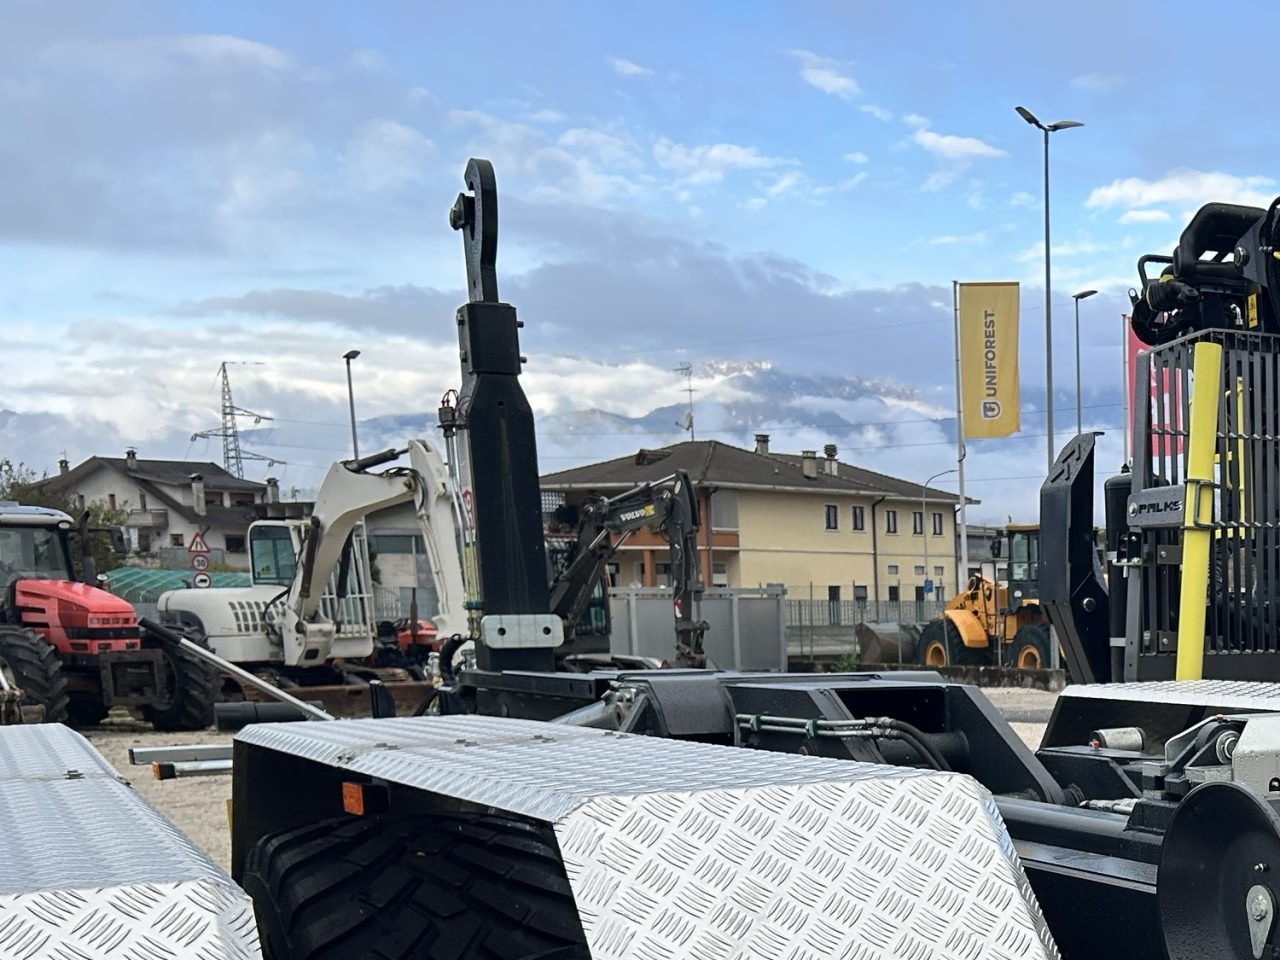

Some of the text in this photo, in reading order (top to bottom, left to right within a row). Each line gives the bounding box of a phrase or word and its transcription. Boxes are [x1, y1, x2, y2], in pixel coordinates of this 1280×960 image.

[984, 310, 997, 398] UNIFOREST
[620, 509, 645, 521] VOLVO
[1138, 500, 1183, 515] PALMS
